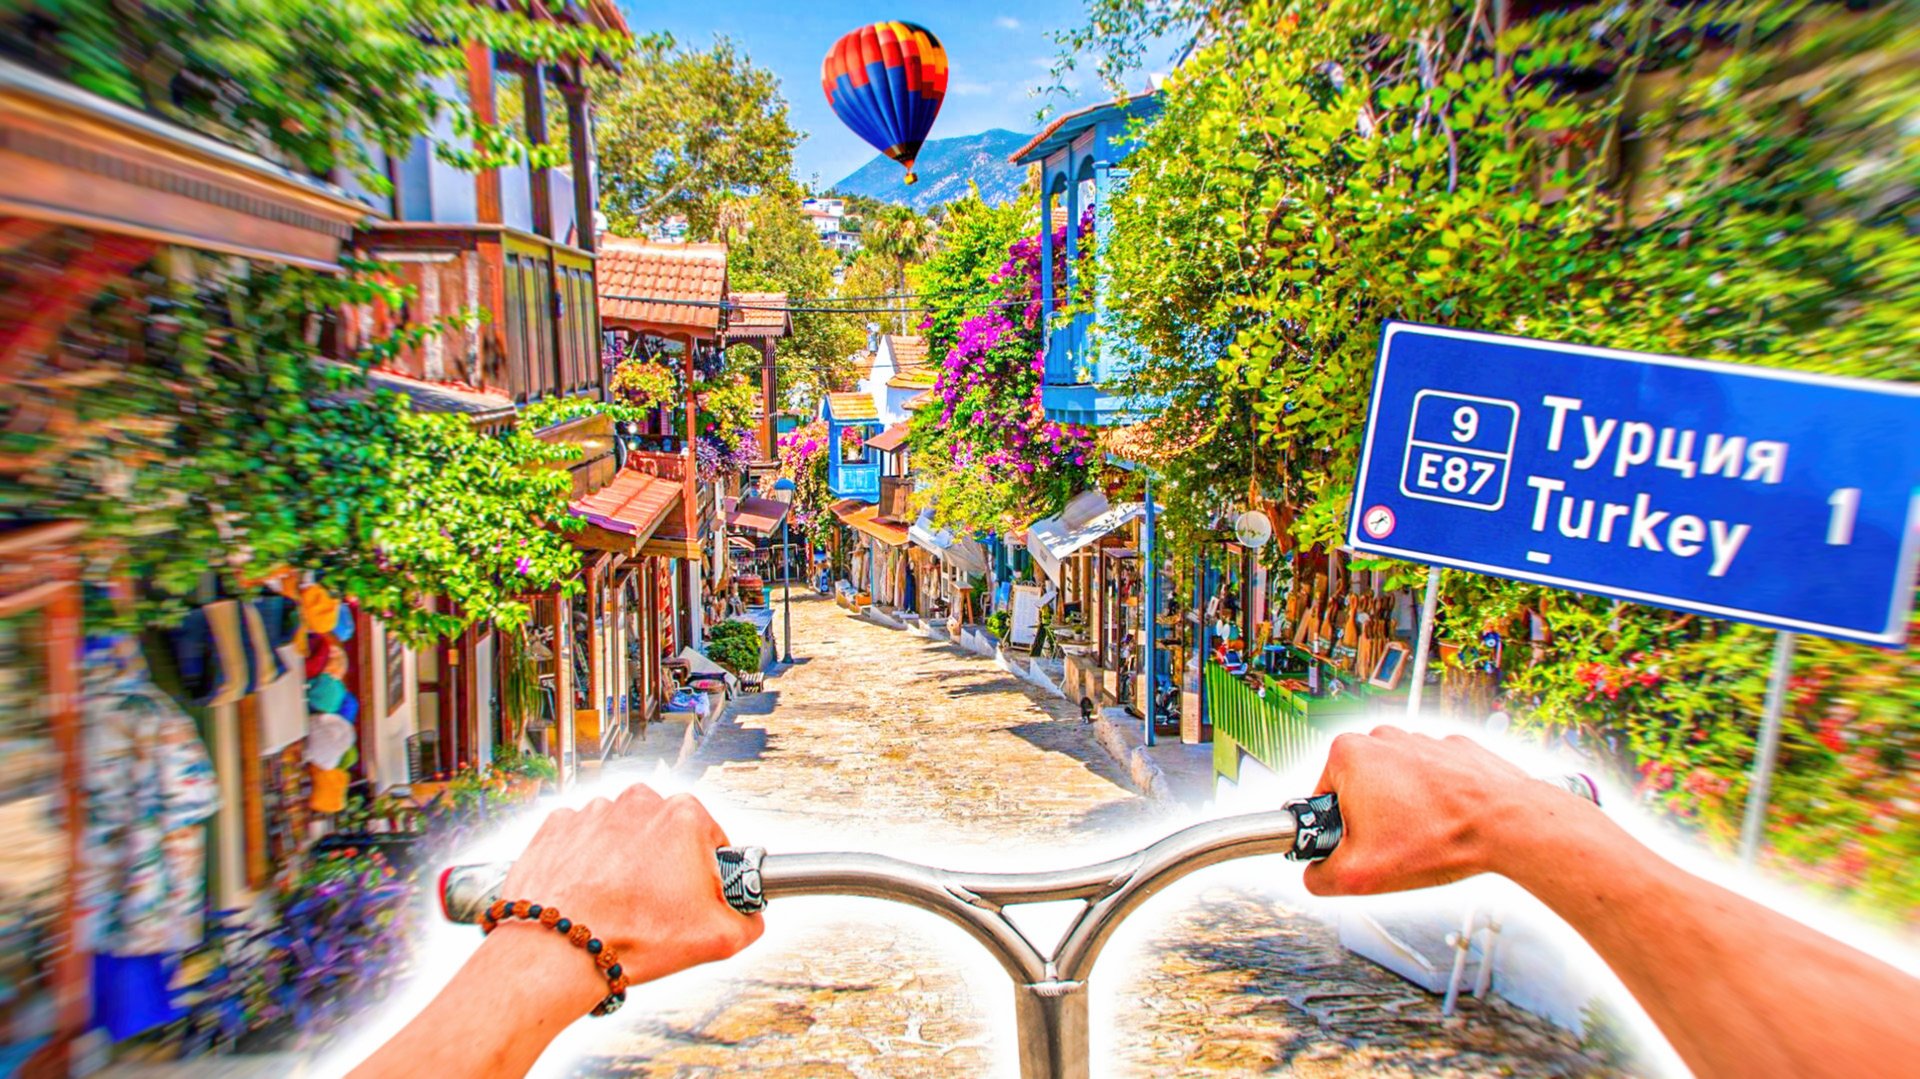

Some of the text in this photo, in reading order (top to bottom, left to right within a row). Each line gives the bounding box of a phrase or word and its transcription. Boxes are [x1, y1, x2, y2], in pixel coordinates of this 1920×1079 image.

[1452, 406, 1479, 442] 9
[1542, 395, 1788, 484] Турция
[1417, 452, 1496, 495] E87
[1527, 475, 1751, 577] Turkey
[1826, 487, 1861, 545] 1
